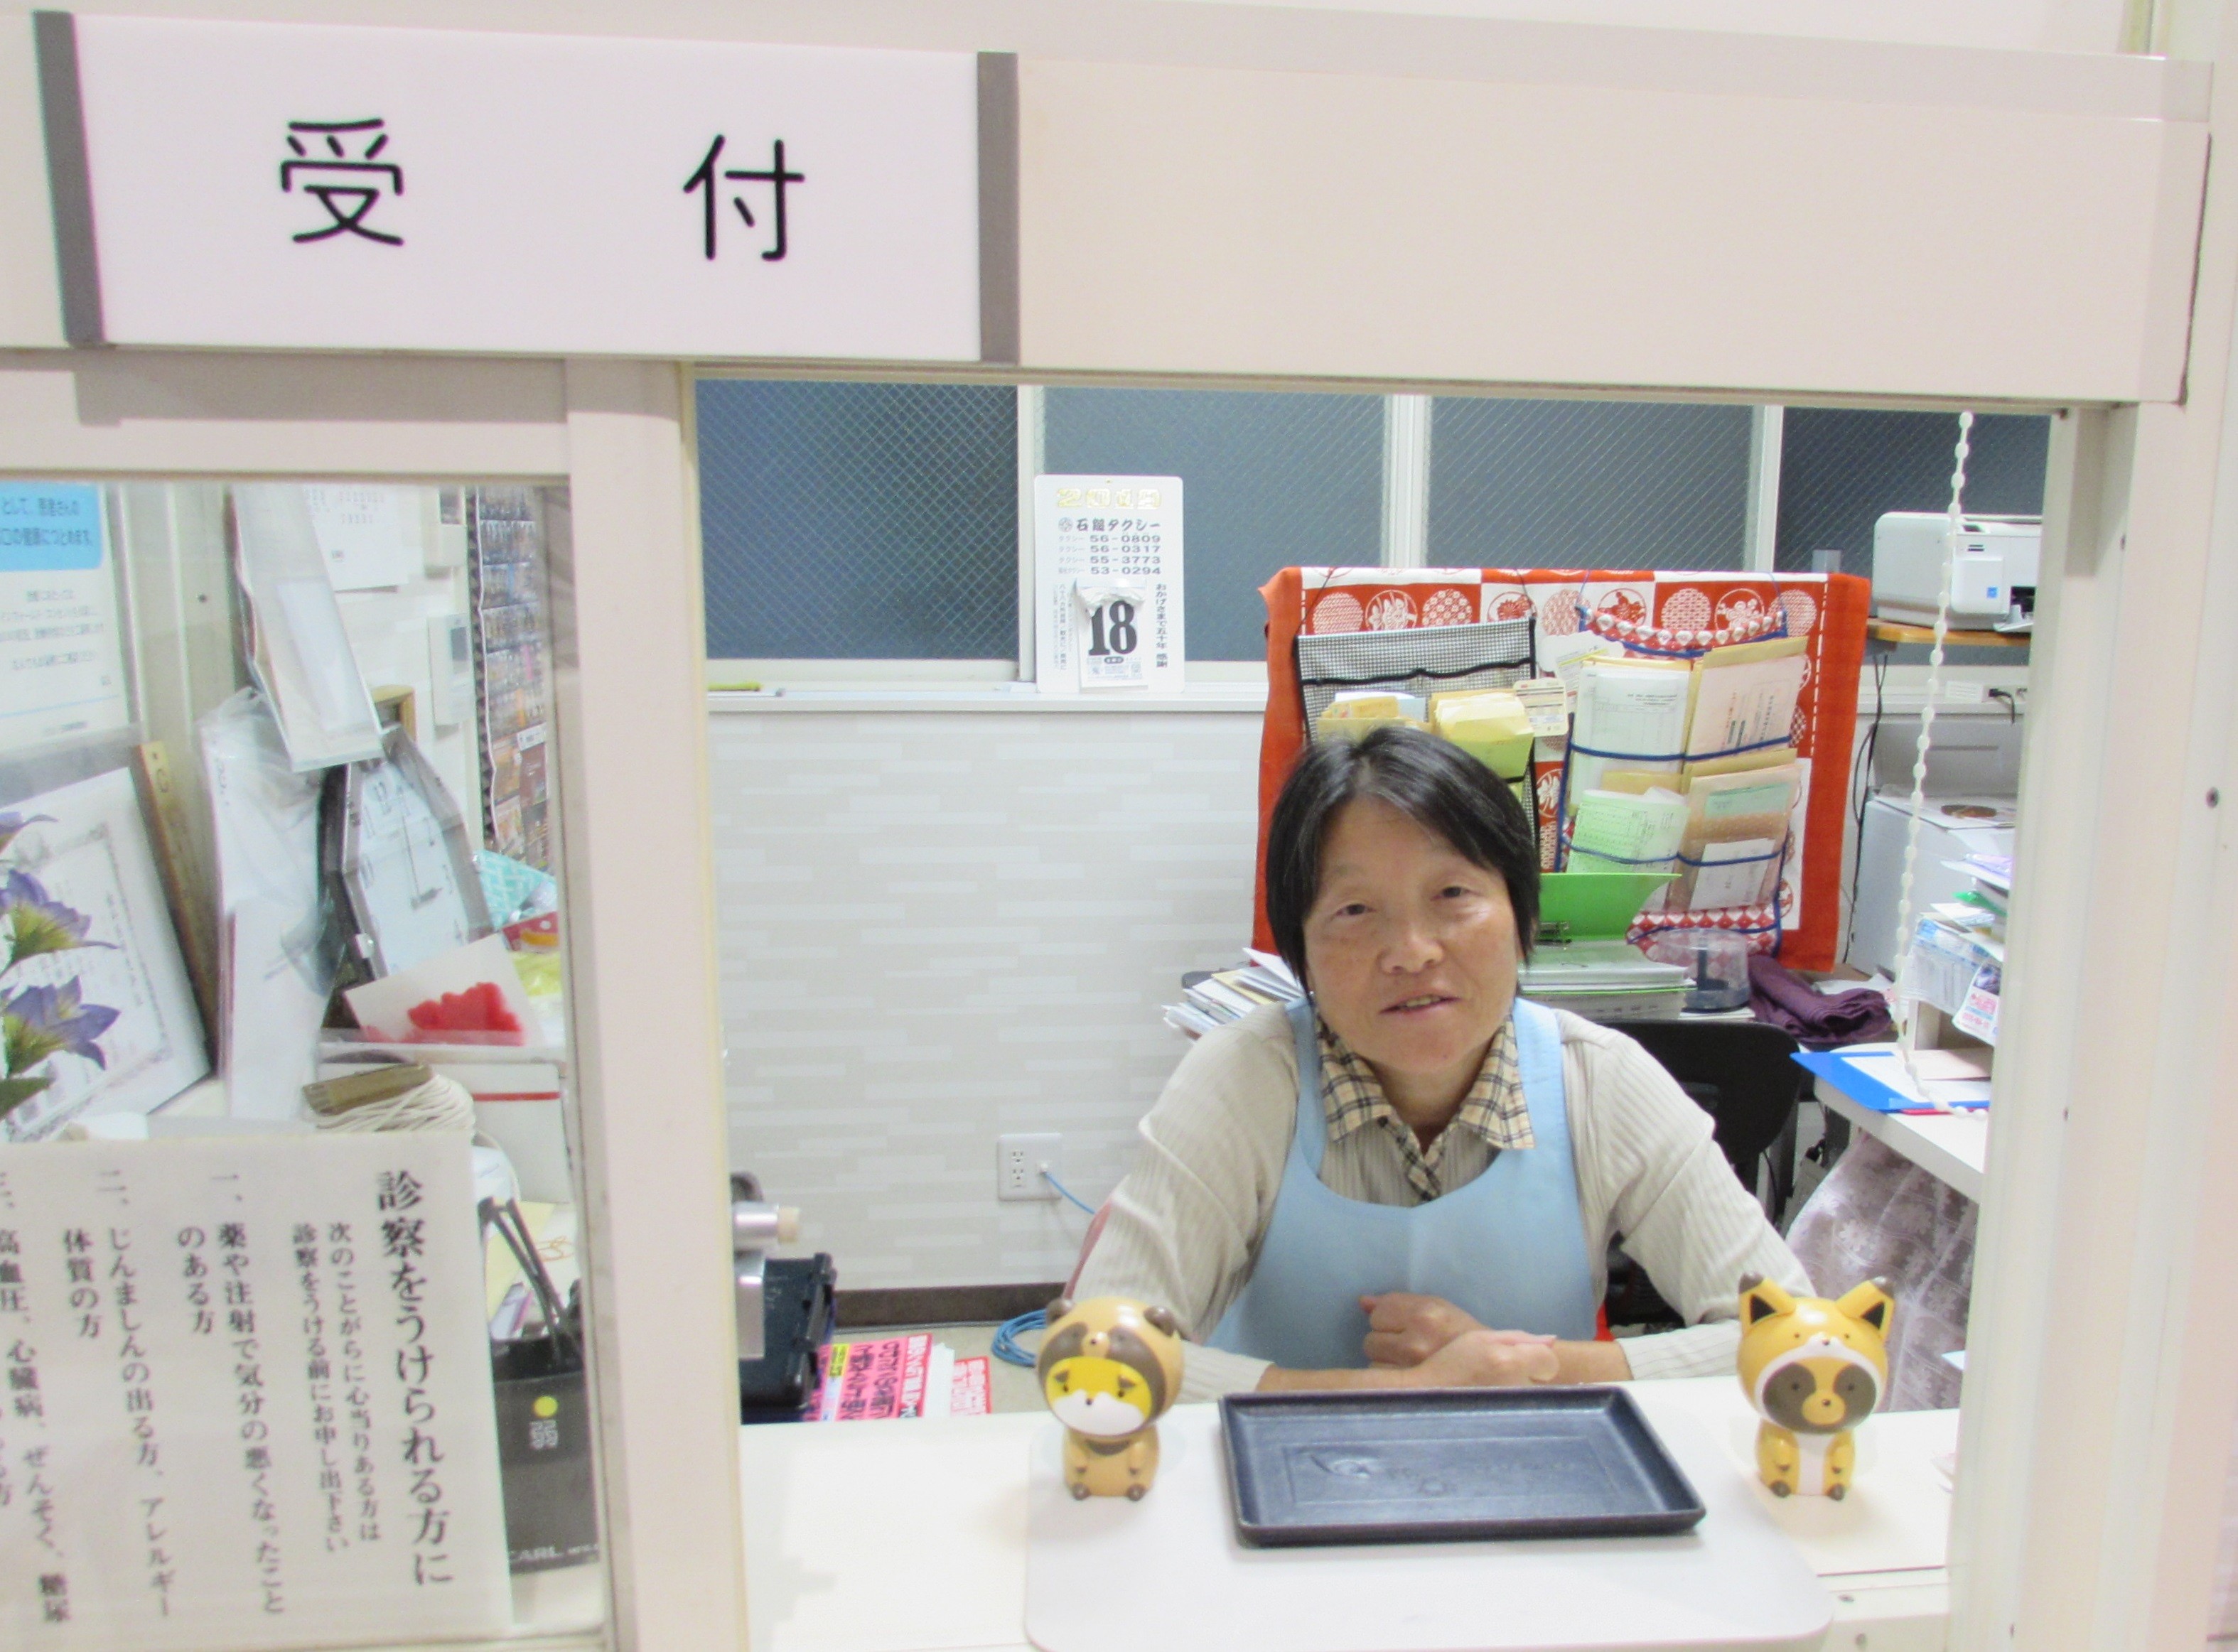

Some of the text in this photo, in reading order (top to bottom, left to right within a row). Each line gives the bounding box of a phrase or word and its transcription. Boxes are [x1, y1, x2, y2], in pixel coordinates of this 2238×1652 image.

[280, 119, 805, 261] 受付
[1057, 488, 1162, 509] 2019
[1090, 534, 1161, 543] 56-0809
[1090, 566, 1161, 575] 53-0294
[1088, 599, 1138, 656] 18
[1156, 652, 1168, 668] 感謝
[63, 1228, 100, 1339] 体質の方
[177, 1226, 213, 1336] のある方
[329, 1222, 382, 1541] 次のことがらに心当りある方は
[377, 1170, 453, 1586] 診察をうけられる方に
[509, 1546, 565, 1561] ARL
